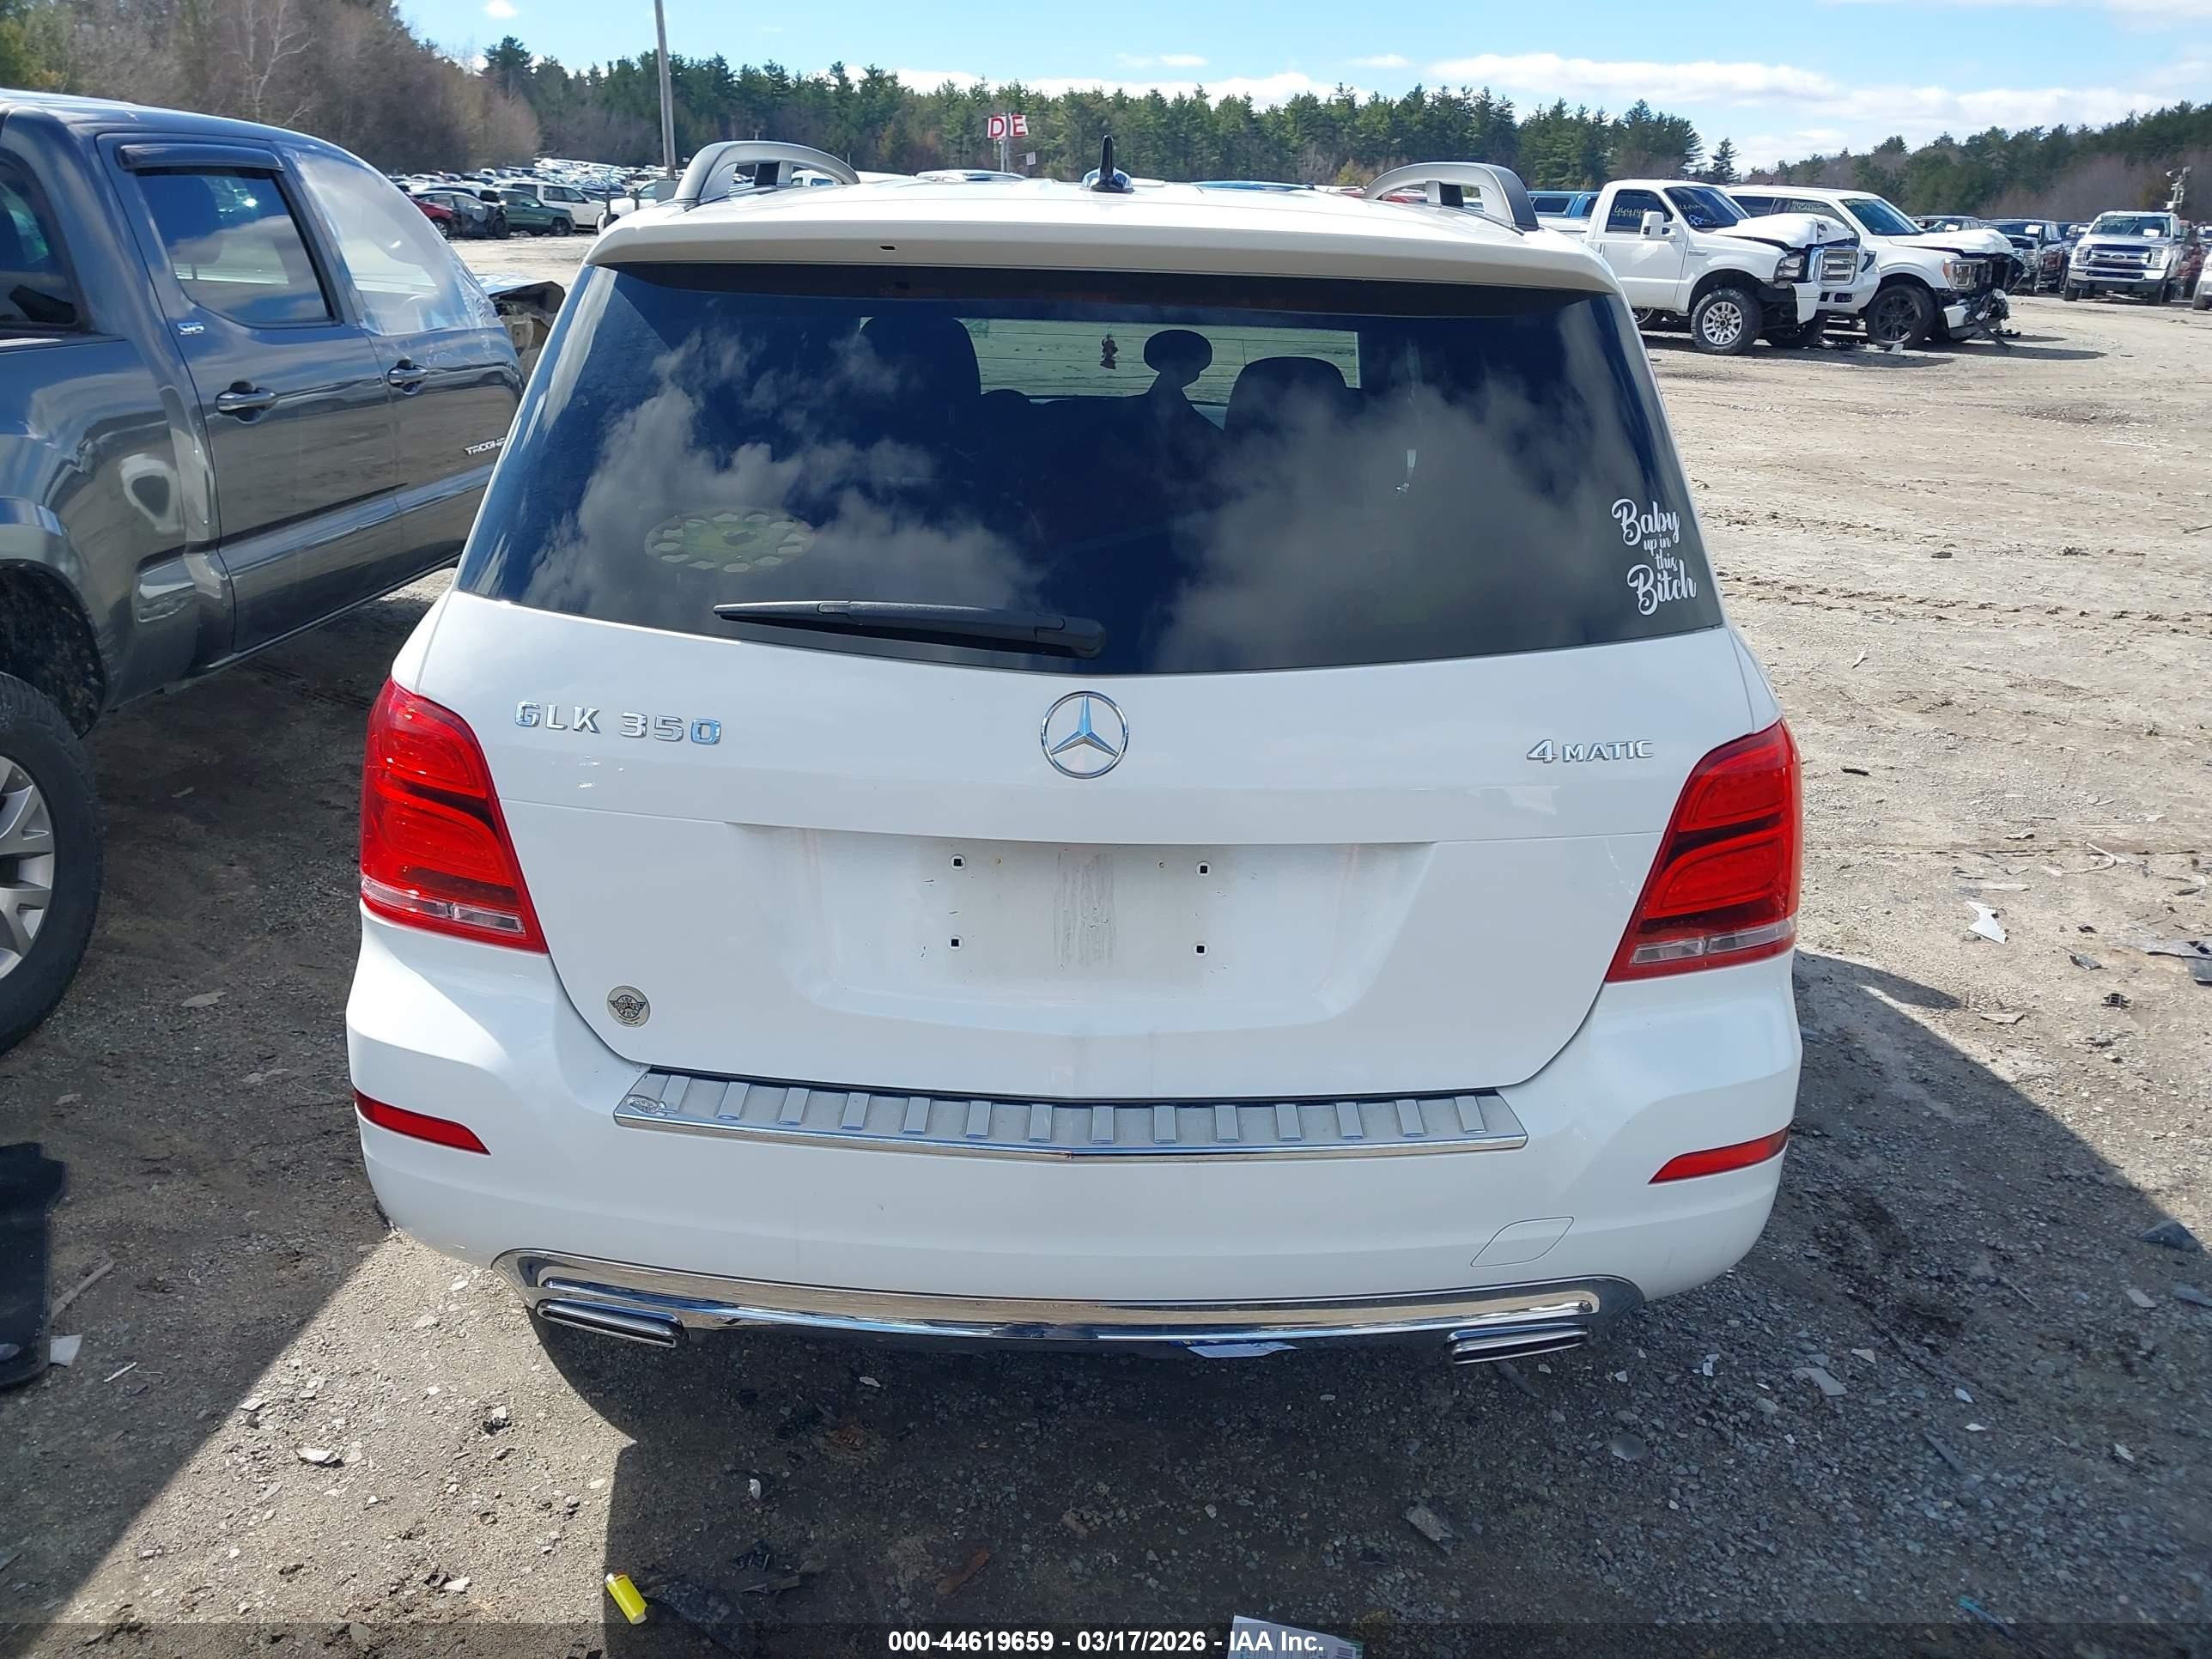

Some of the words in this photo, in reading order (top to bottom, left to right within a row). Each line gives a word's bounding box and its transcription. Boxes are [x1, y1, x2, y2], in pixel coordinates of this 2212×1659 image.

[990, 118, 1005, 137] D
[1012, 115, 1026, 136] E
[1611, 498, 1680, 546] Baby
[1644, 538, 1657, 556] up
[1659, 533, 1672, 549] in
[1654, 548, 1679, 572] this
[1626, 559, 1697, 616] Bitch
[515, 701, 601, 734] GLK
[619, 712, 721, 744] 350
